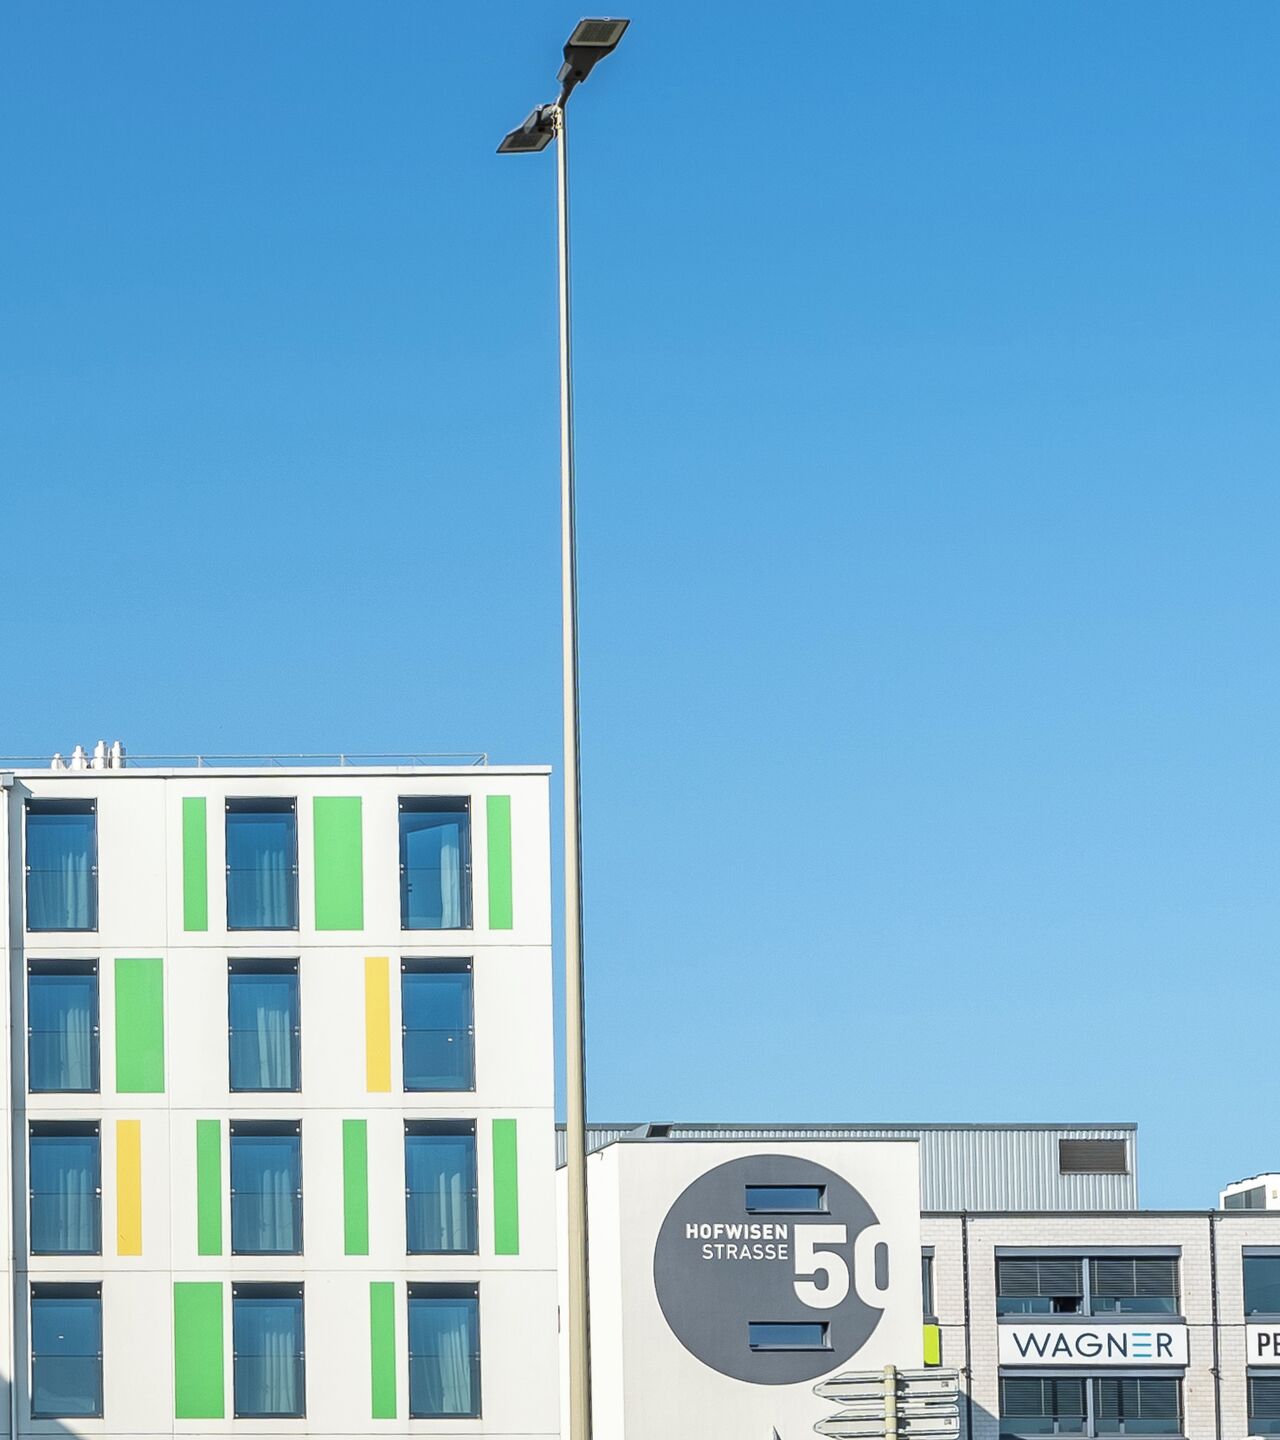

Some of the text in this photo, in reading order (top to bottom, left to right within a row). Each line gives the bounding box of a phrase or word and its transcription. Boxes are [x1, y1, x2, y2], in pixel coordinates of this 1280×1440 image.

[685, 1223, 788, 1240] HOFWISEN
[702, 1244, 789, 1260] STRASSE
[793, 1224, 895, 1310] 50
[1012, 1332, 1174, 1358] WAGNER
